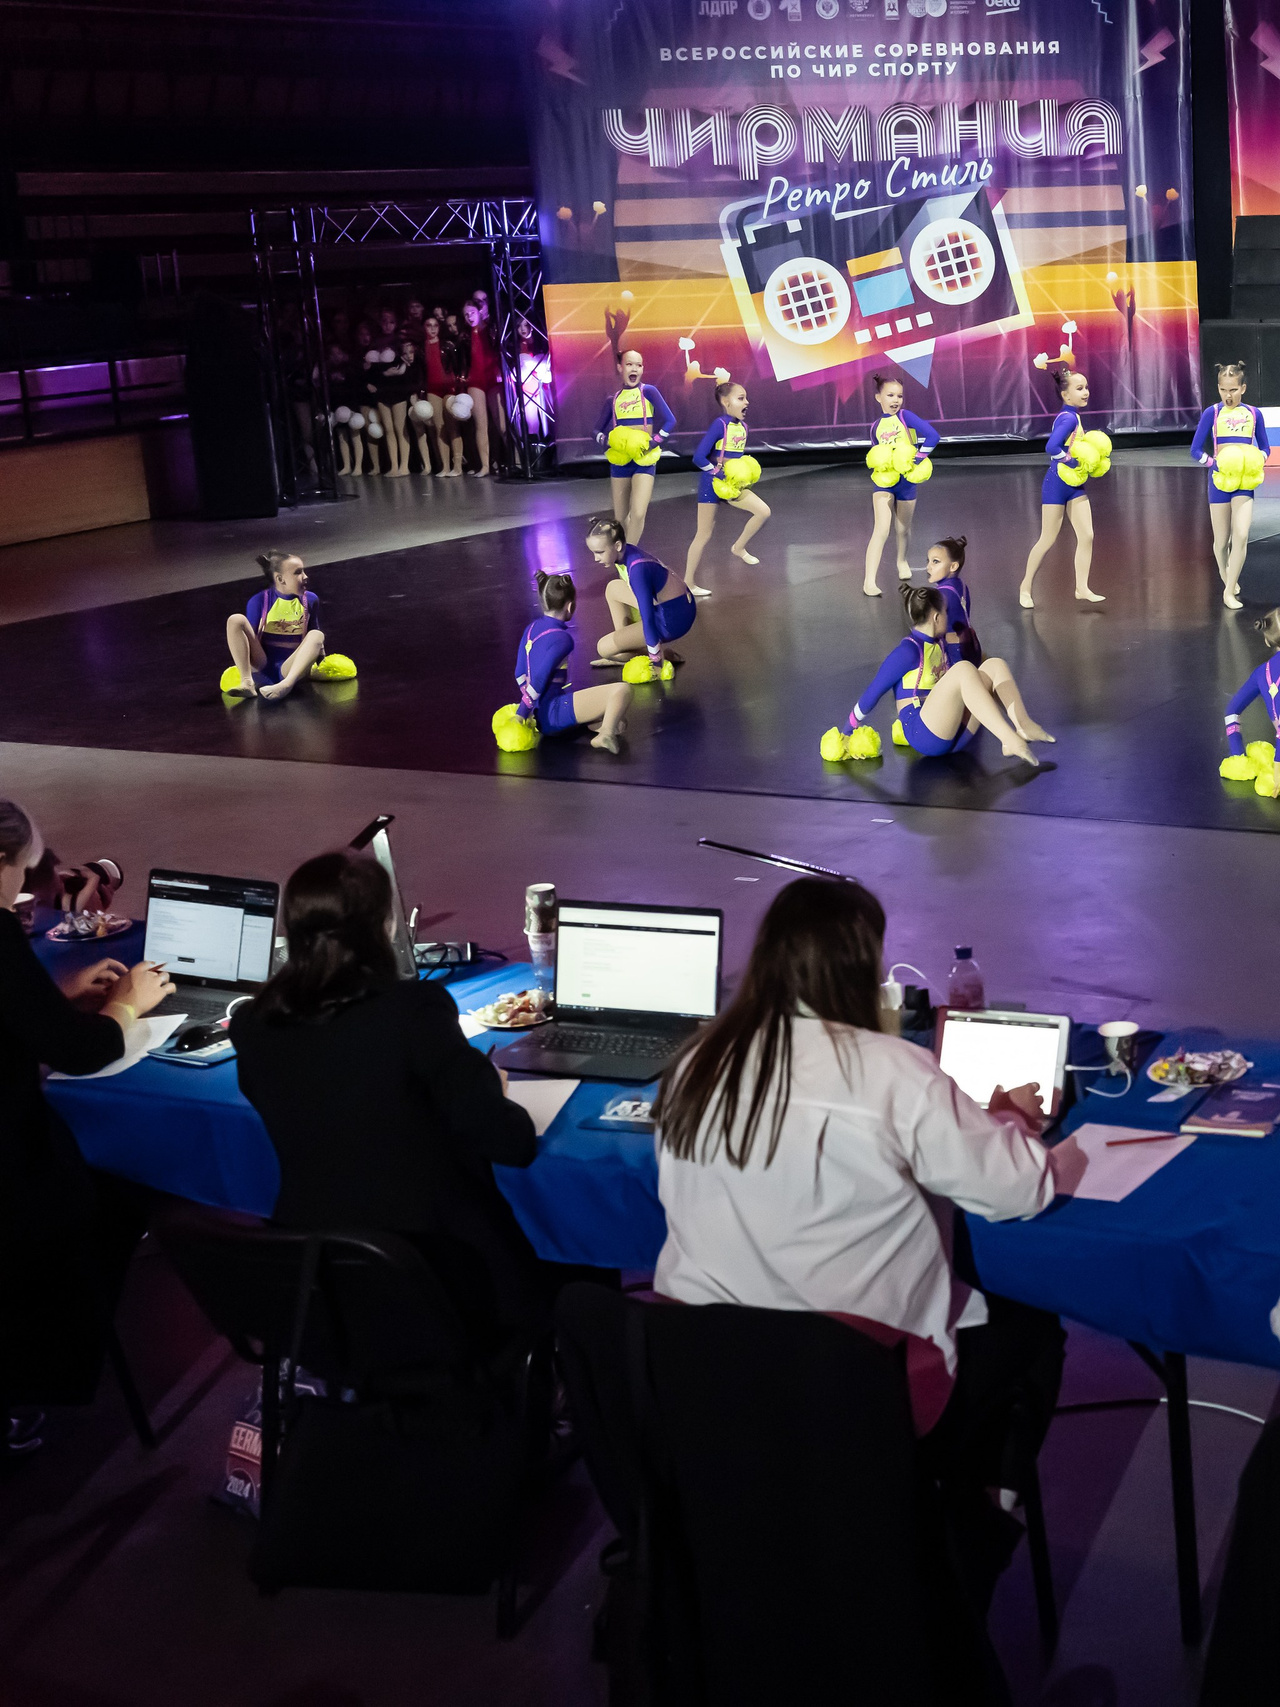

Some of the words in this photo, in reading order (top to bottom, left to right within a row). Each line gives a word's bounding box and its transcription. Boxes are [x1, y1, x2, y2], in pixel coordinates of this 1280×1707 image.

[659, 42, 864, 62] ВСЕРОССИЙСКИЕ
[874, 40, 1061, 58] СОРЕВНОВАНИЯ
[770, 64, 801, 78] ПО
[812, 64, 858, 78] ЧИР
[868, 61, 958, 77] СПОРТУ
[762, 175, 871, 219] Ретро
[885, 156, 994, 199] Стиль
[226, 1475, 252, 1498] 2024
